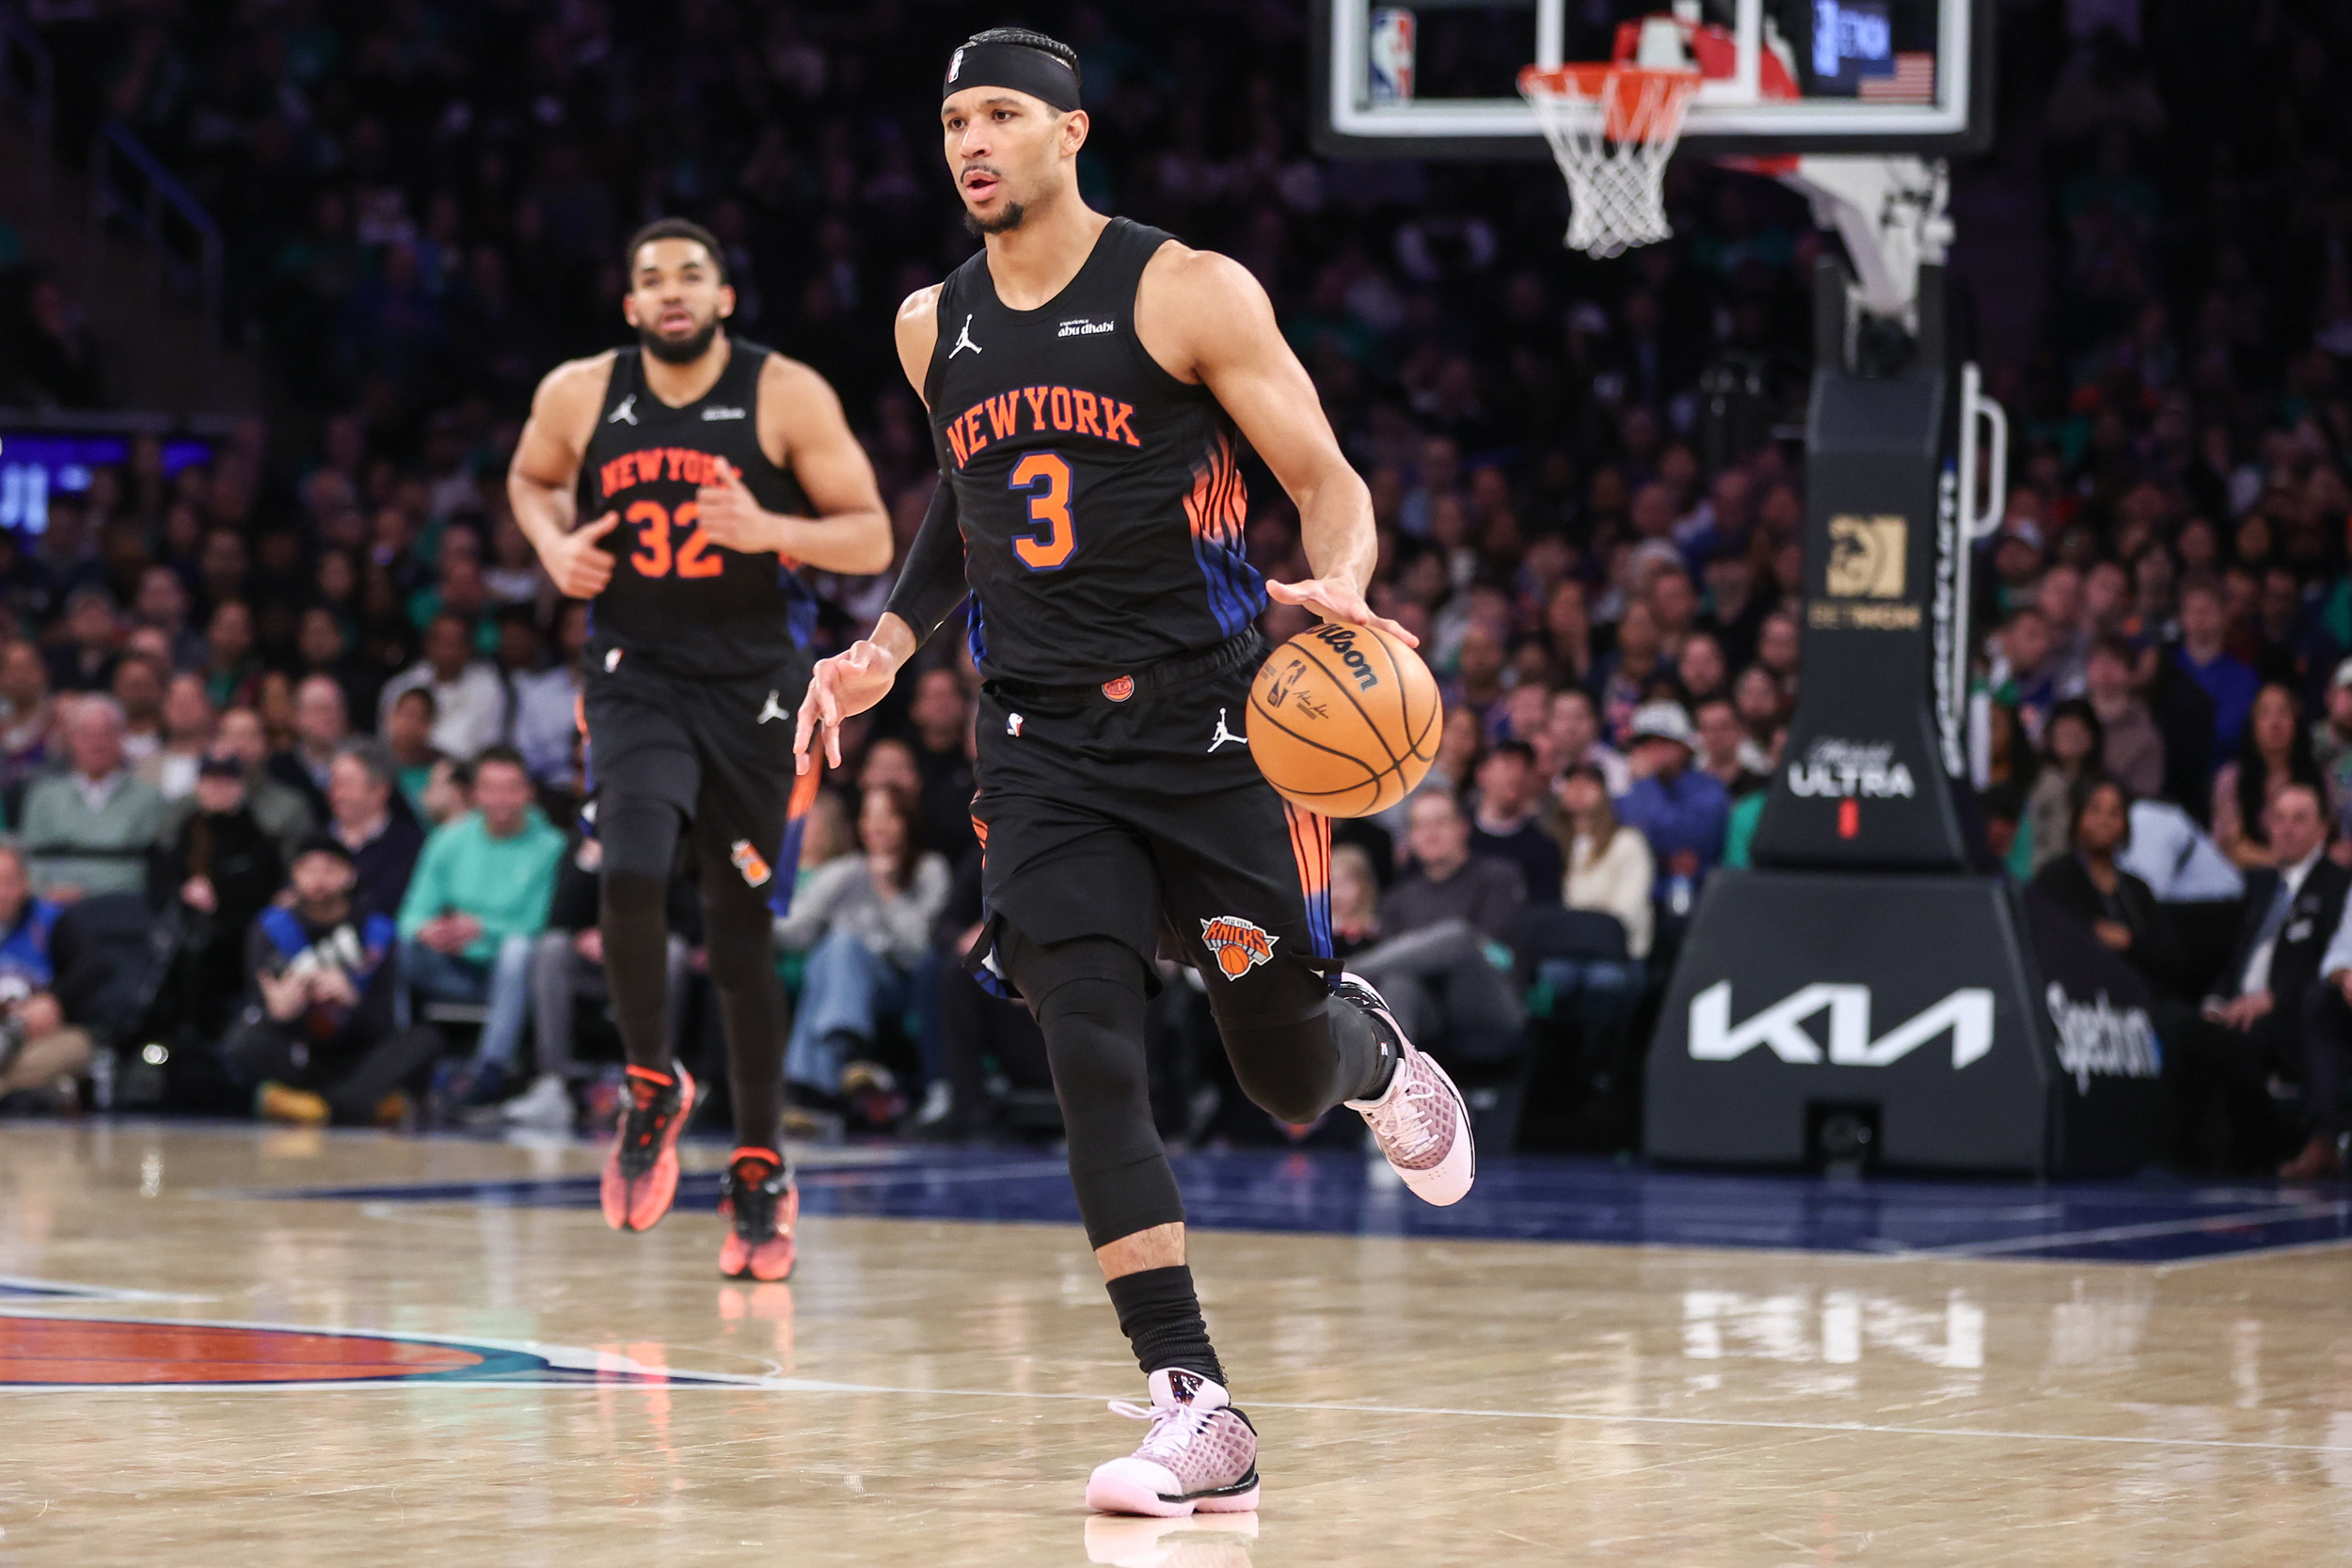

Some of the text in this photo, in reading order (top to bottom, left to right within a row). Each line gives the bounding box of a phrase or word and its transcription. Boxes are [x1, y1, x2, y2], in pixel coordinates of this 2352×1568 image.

[1057, 321, 1115, 338] abu dhabi
[946, 386, 1141, 470] NEW YORK
[599, 447, 664, 499] NEW
[625, 499, 724, 578] 32
[1008, 449, 1079, 573] 3
[1788, 761, 1915, 798] ULTRA
[1204, 920, 1271, 958] KNICKS
[1688, 979, 1995, 1070] KIA
